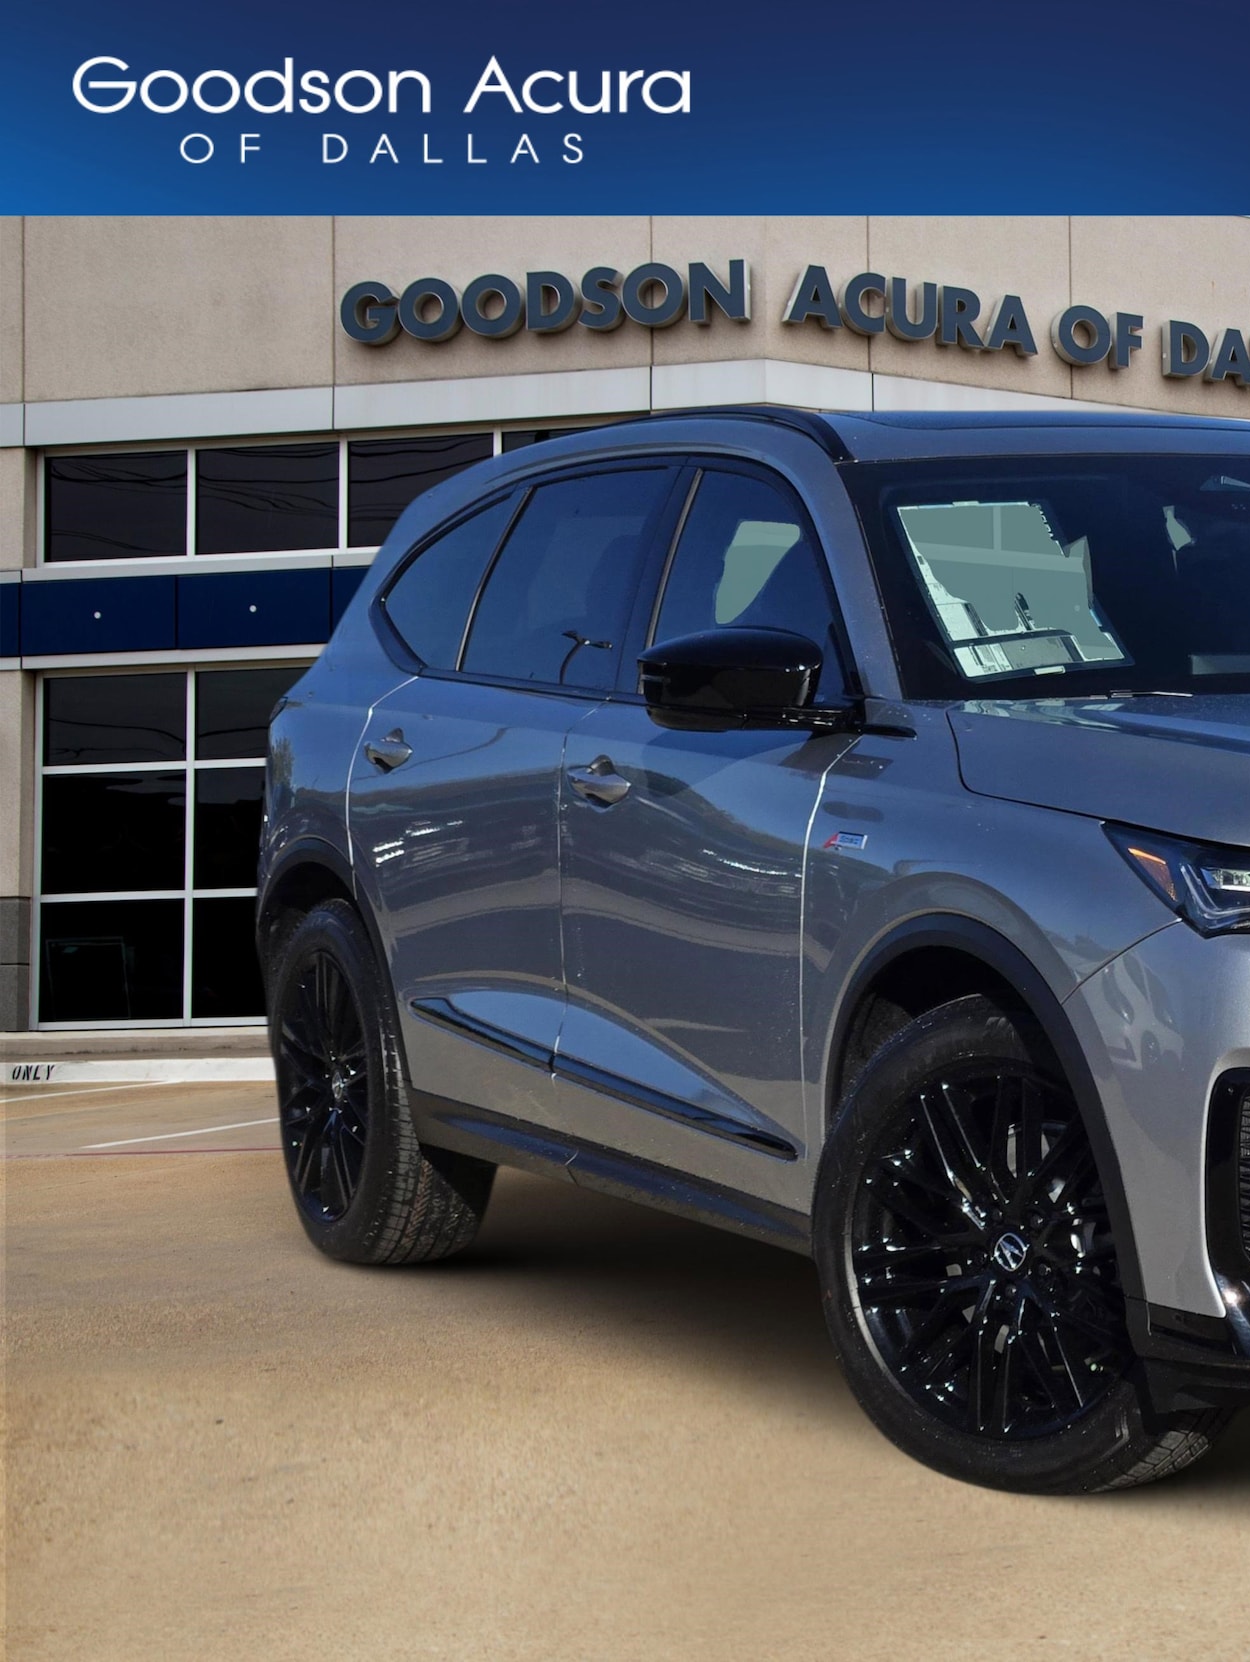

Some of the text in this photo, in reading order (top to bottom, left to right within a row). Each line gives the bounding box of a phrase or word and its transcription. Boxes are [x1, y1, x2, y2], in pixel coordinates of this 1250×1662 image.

[340, 259, 750, 345] GOODSON
[782, 264, 1038, 356] ACURA
[1051, 304, 1144, 370] OF
[11, 1064, 55, 1081] ONLY
